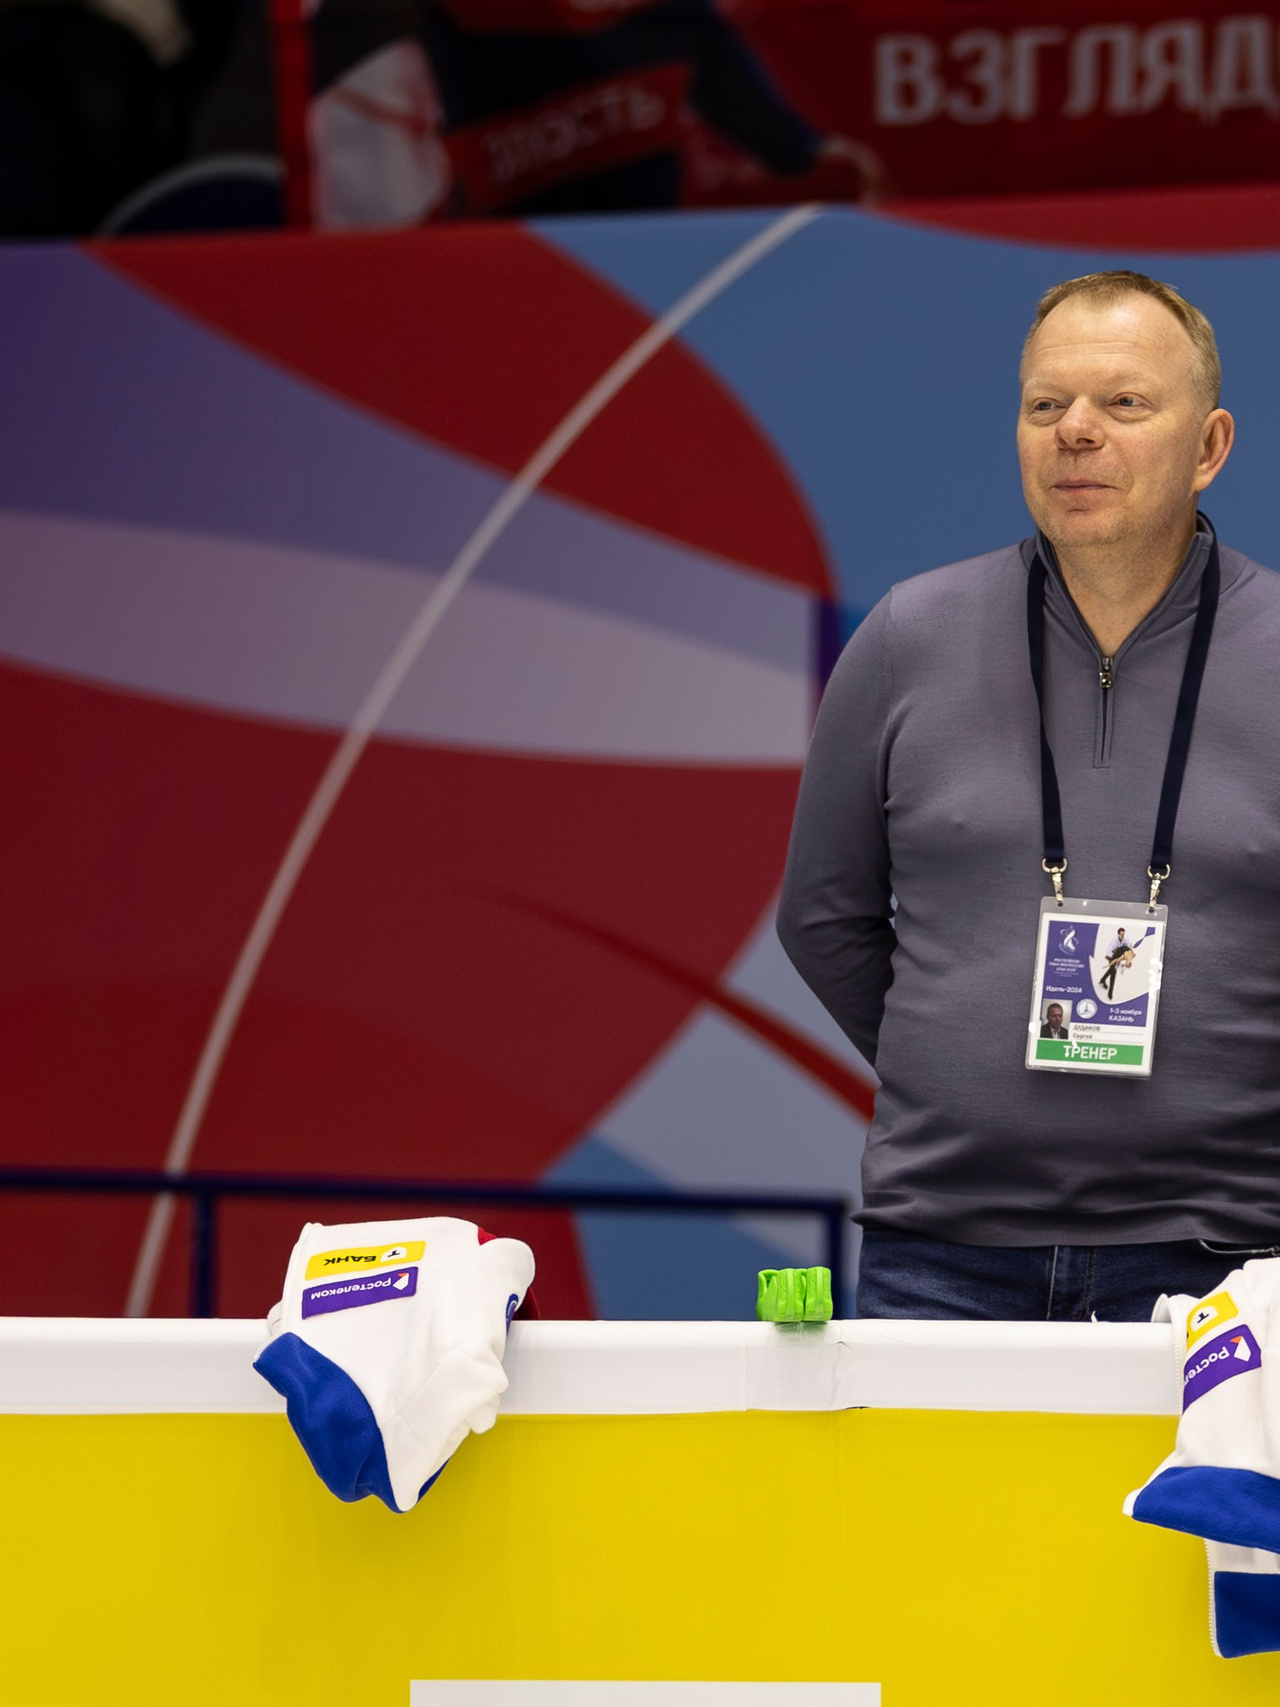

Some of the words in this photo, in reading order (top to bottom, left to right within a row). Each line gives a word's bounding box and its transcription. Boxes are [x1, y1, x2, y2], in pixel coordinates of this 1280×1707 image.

[1063, 1045, 1117, 1060] ТРЕНЕР
[323, 1255, 377, 1266] БАНК
[311, 1277, 391, 1300] Ростелеком
